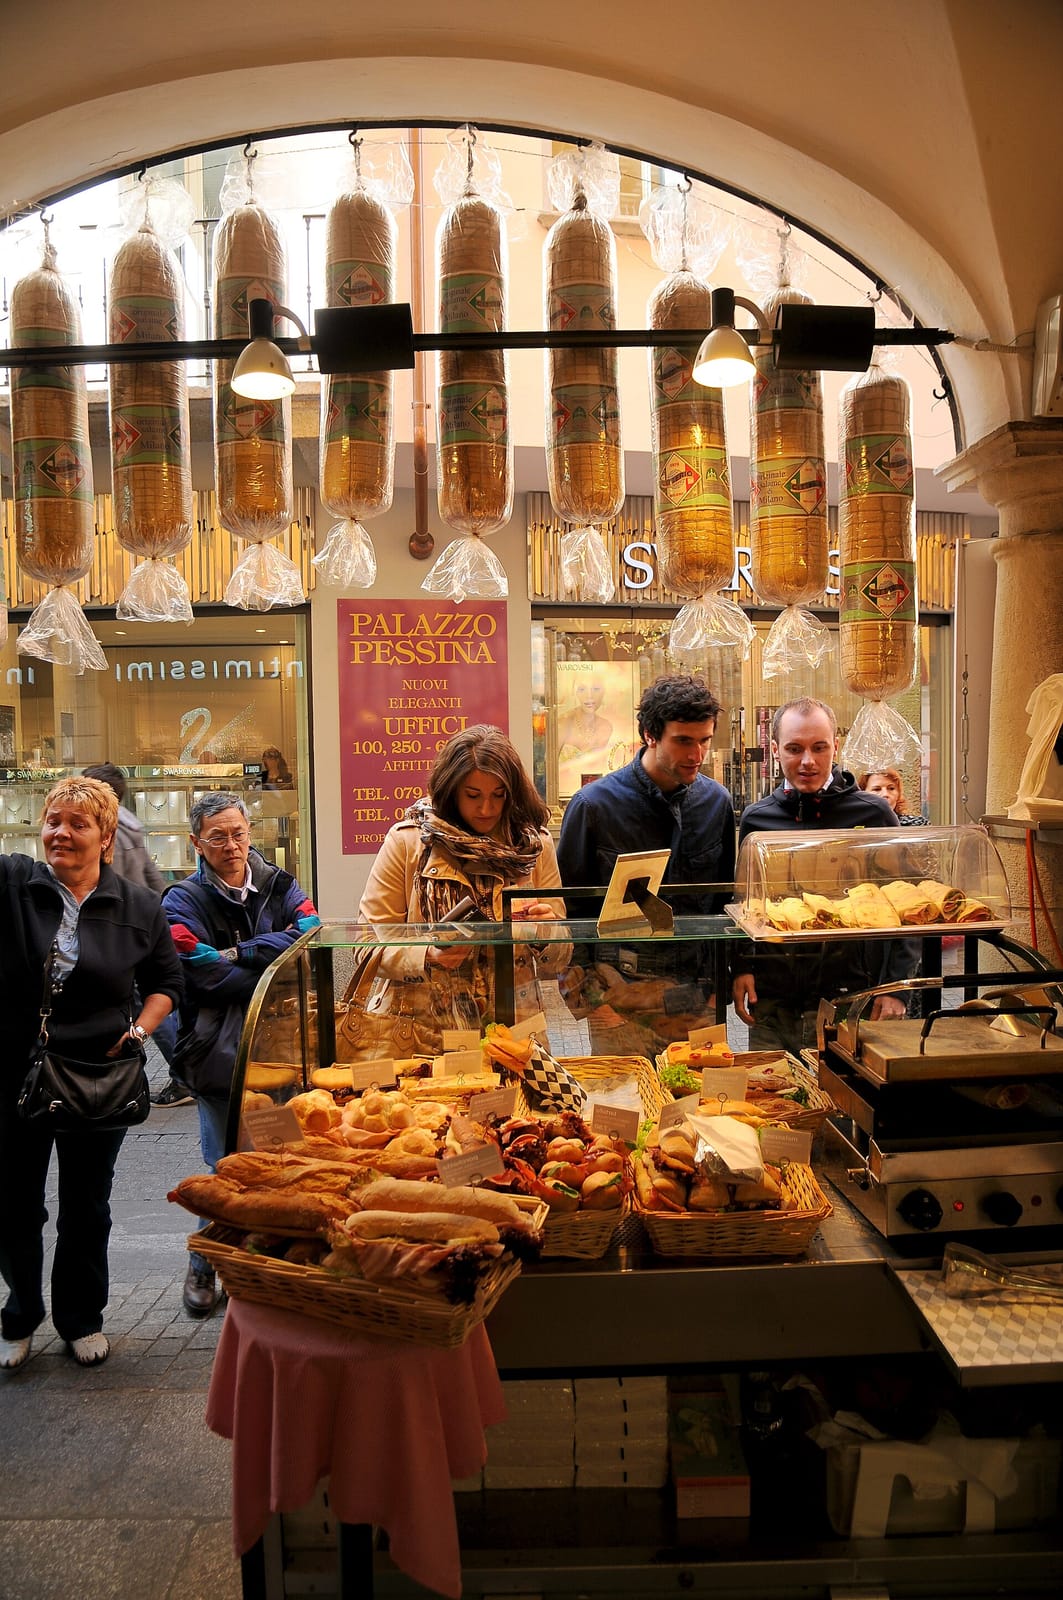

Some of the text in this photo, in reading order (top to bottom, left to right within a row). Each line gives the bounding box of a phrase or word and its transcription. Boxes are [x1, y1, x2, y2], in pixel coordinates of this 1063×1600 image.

[350, 613, 497, 638] PALAZZO
[350, 640, 496, 665] PESSINA
[556, 663, 594, 671] WAROVSKI
[402, 679, 449, 691] NUOVI
[388, 697, 463, 709] ELEGANTI
[383, 716, 469, 736] UFFICI
[352, 741, 387, 757] 100,
[391, 740, 422, 755] 250
[435, 740, 449, 754] 6
[382, 759, 434, 772] AFFITT
[353, 787, 423, 801] TEL. 079
[353, 807, 390, 822] TEL.
